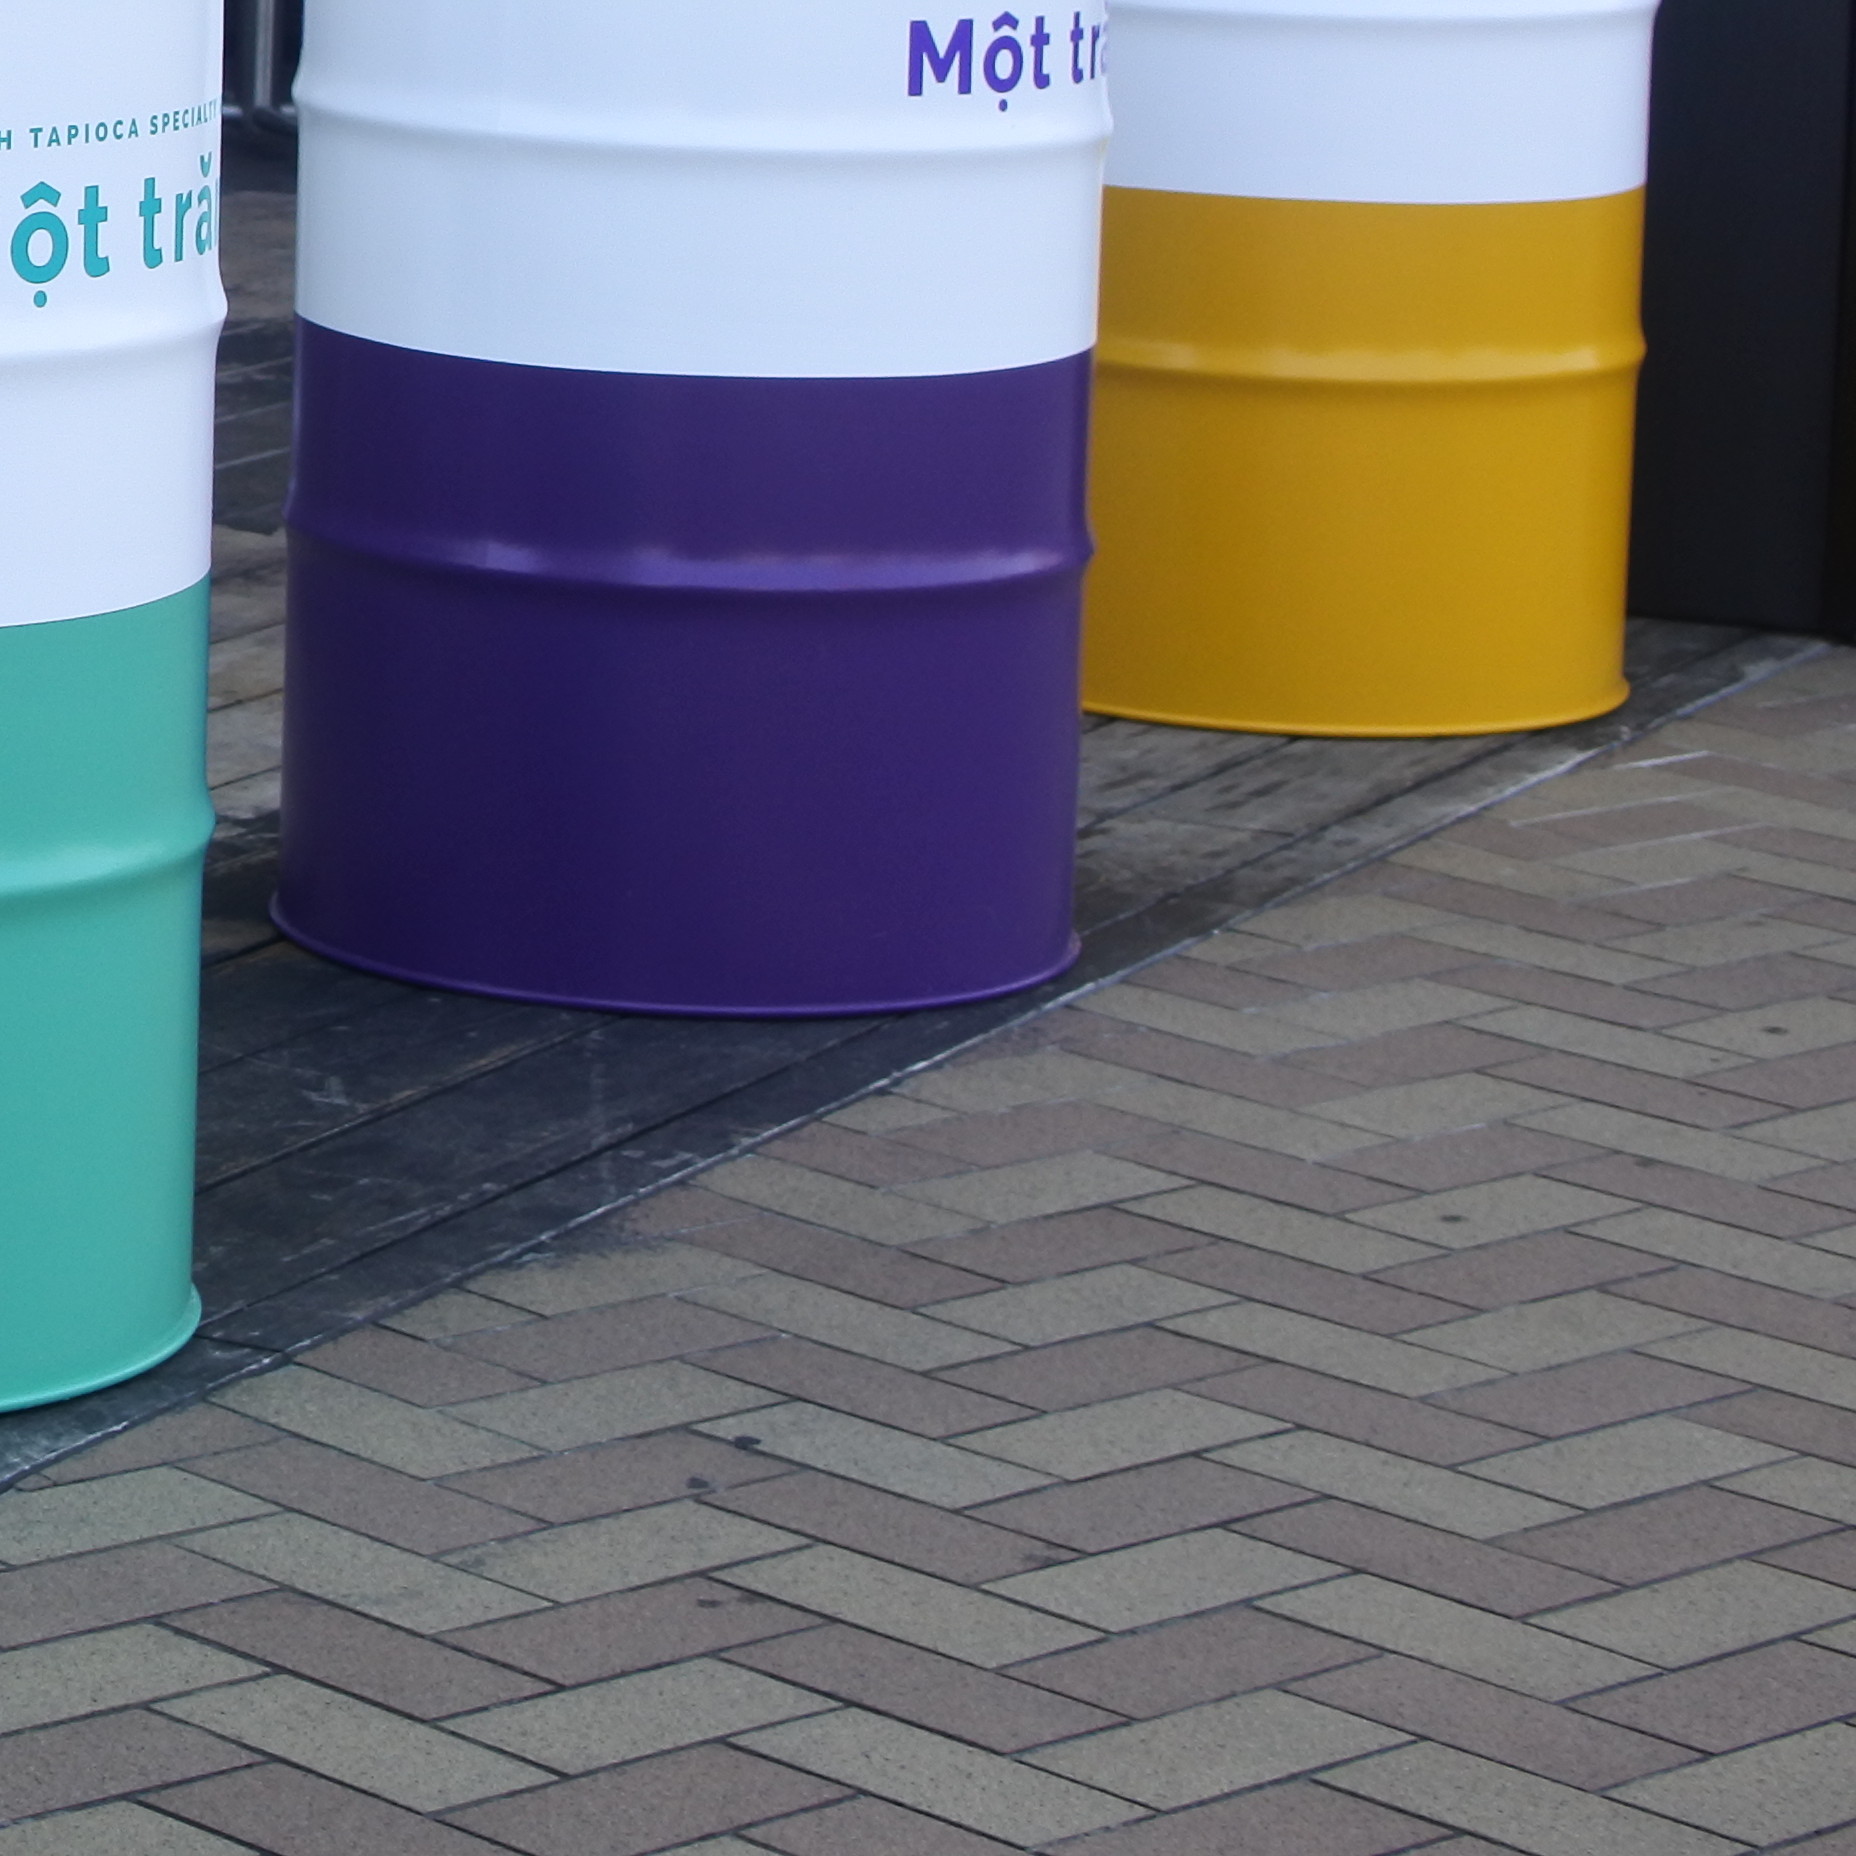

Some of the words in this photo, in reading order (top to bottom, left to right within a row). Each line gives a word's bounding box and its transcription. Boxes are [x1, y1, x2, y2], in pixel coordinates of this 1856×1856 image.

[907, 10, 1051, 113] Một
[29, 118, 140, 148] TAPIOCA
[138, 151, 220, 270] tră
